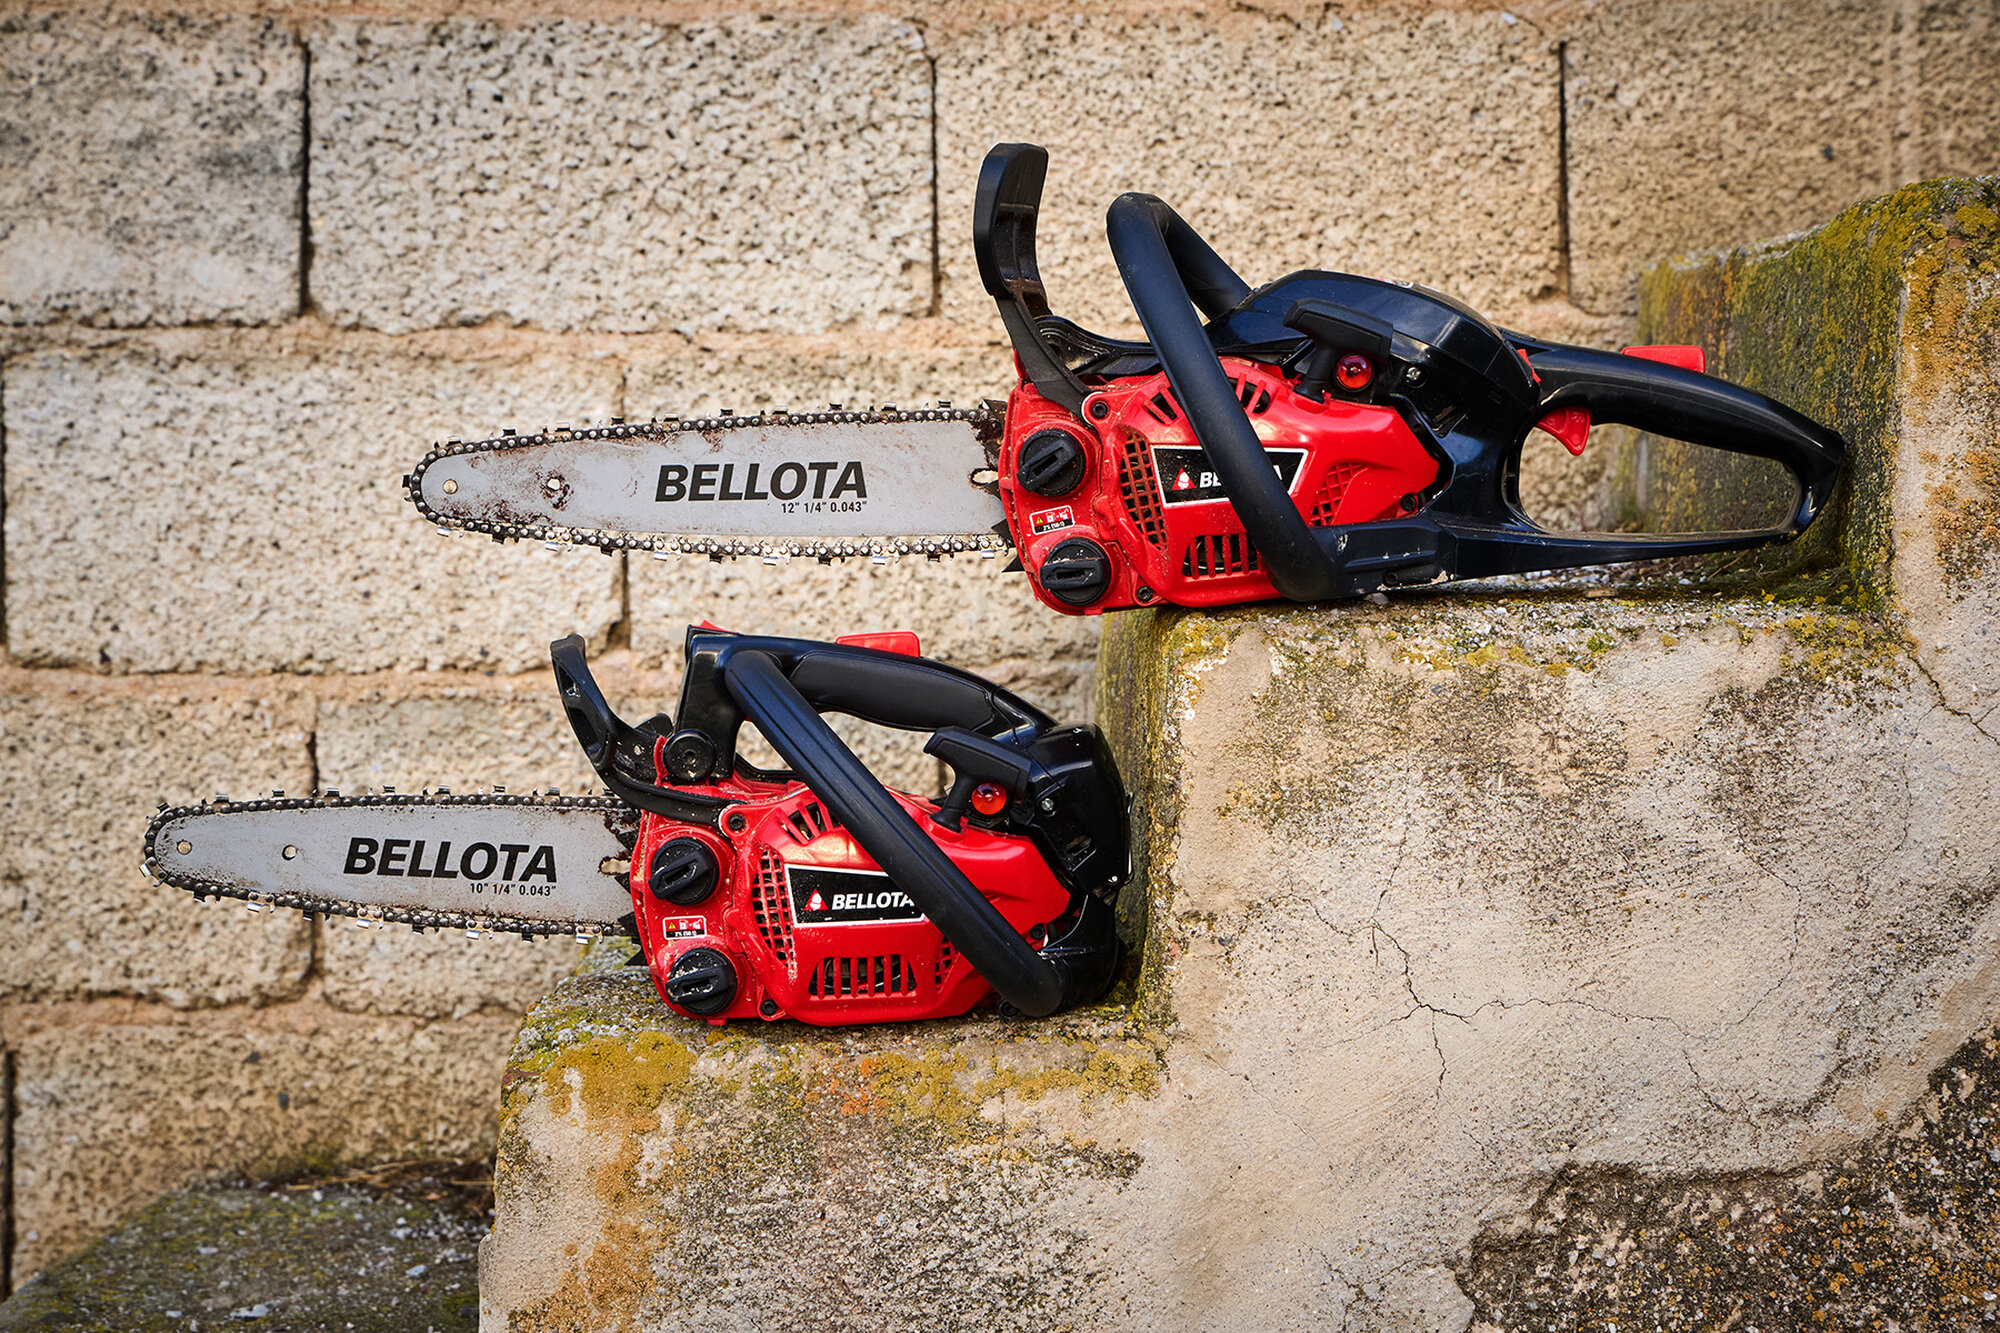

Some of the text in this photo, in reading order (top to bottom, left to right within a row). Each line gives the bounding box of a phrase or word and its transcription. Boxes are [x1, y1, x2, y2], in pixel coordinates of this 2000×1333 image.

[655, 461, 867, 502] BELLOTA
[781, 501, 867, 513] 12" 1/4" 0.043"
[343, 837, 557, 883] BELLOTA
[470, 883, 556, 897] 10" 1/4" 0.043"
[831, 892, 915, 910] BELLOTA
